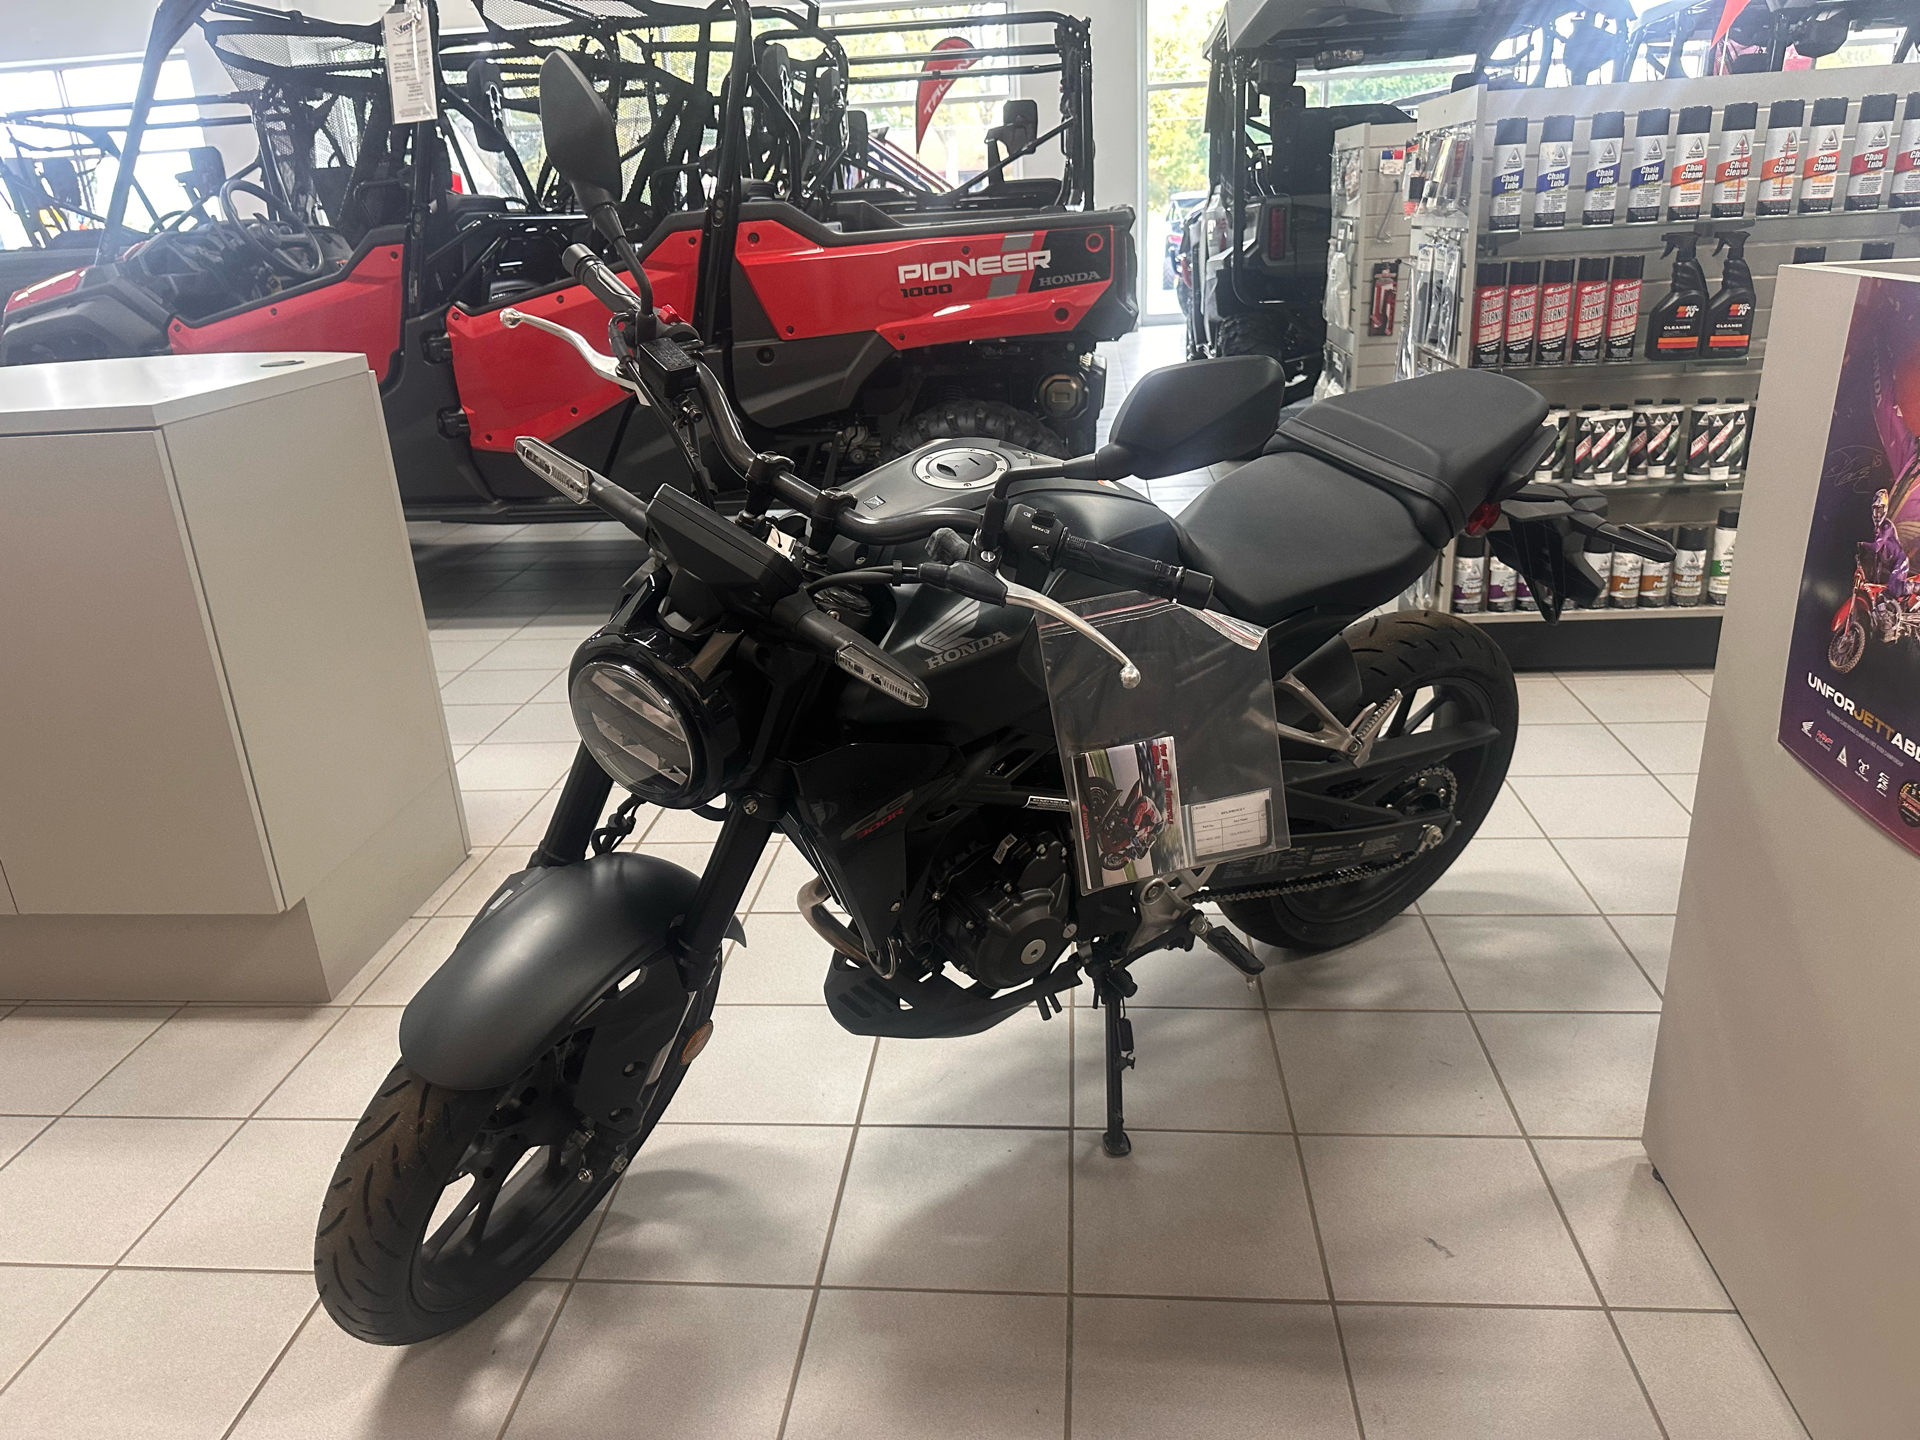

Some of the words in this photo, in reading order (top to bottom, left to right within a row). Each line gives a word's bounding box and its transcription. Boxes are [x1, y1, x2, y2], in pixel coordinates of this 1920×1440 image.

[1818, 155, 1837, 164] Chain
[1864, 152, 1884, 161] Chain
[1686, 163, 1704, 172] Chain
[1813, 163, 1837, 172] Cleaner
[1867, 160, 1883, 168] Lube
[1596, 168, 1614, 177] Chain
[1641, 165, 1659, 174] Chain
[1501, 174, 1520, 183] Chain
[1547, 172, 1565, 181] Chain
[1644, 173, 1659, 181] Lube
[1681, 171, 1704, 179] Cleaner
[1550, 179, 1565, 188] Lube
[1599, 176, 1614, 184] Lube
[1505, 182, 1520, 190] Lube
[898, 250, 1051, 284] PIONEER
[1039, 271, 1101, 287] HONDA
[900, 284, 952, 298] 1000
[925, 631, 1011, 670] HONDA
